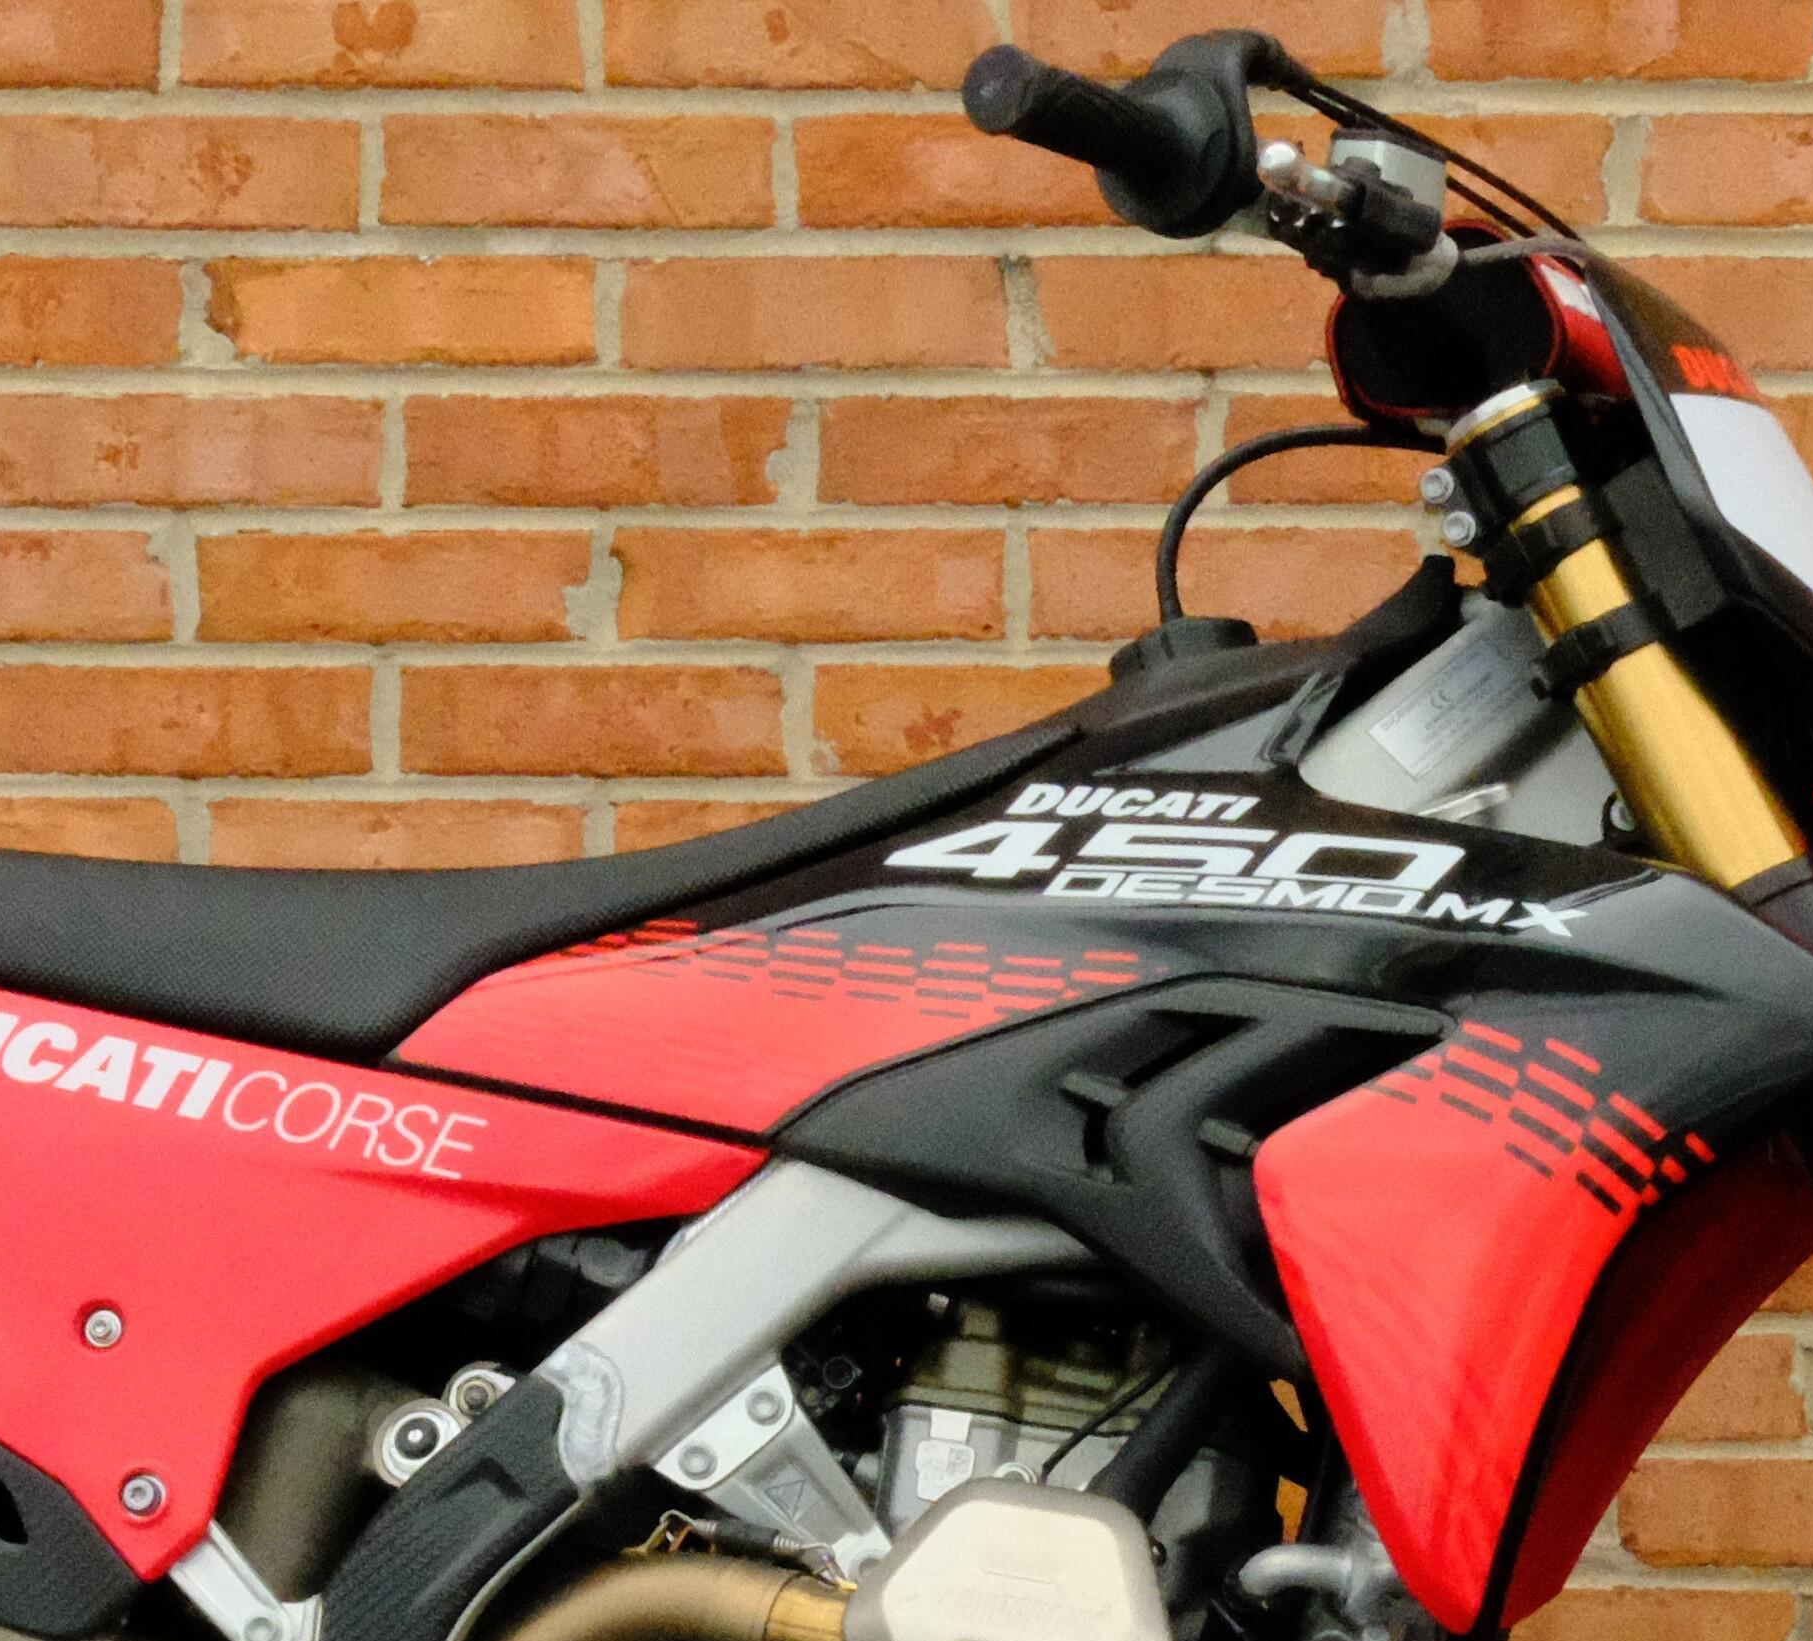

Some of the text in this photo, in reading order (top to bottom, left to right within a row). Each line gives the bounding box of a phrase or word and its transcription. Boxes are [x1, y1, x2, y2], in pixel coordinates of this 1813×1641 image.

[1005, 782, 1260, 822] DUCATI
[882, 819, 1467, 892] 450
[1043, 865, 1591, 938] DESMO MX
[223, 1070, 488, 1179] CORSE
